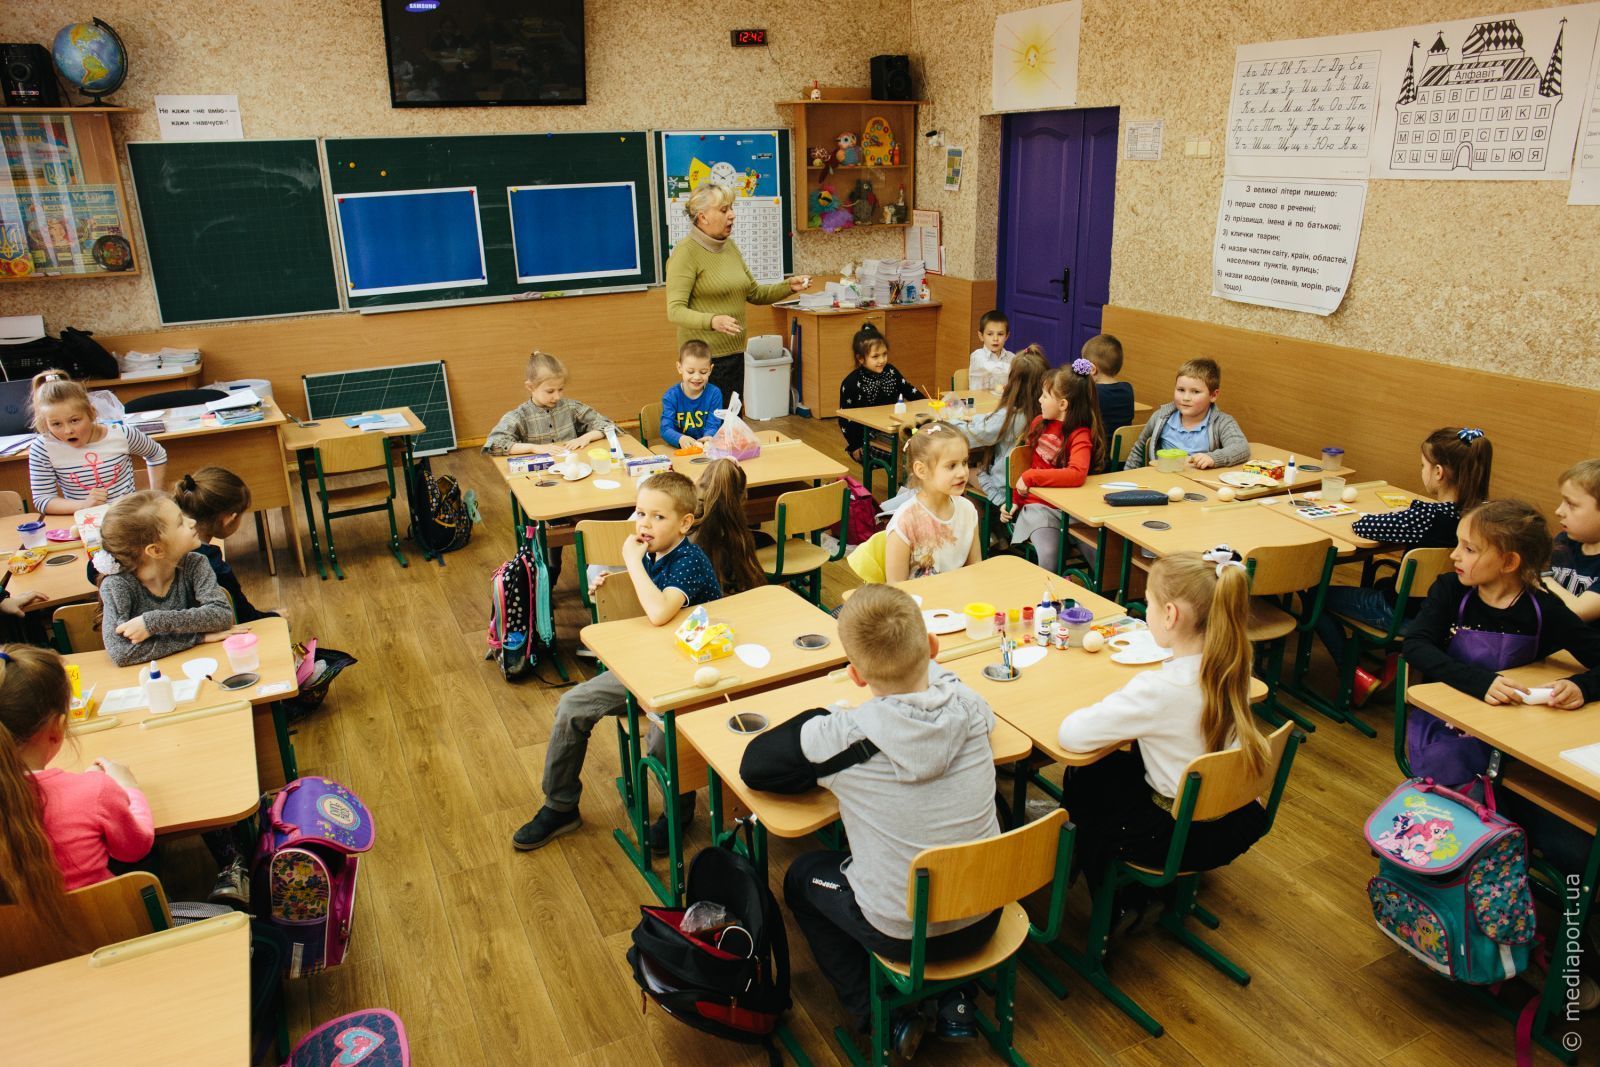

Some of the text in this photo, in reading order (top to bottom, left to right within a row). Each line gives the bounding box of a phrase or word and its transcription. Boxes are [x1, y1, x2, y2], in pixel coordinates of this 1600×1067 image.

[740, 32, 764, 42] 12:42
[1455, 69, 1496, 80] Алфавіт
[1420, 94, 1426, 102] А
[1435, 93, 1442, 101] Б
[1452, 92, 1458, 101] В
[1469, 92, 1475, 100] Г
[1503, 88, 1512, 98] Д
[1524, 87, 1531, 97] Е
[1402, 113, 1409, 122] Є
[1415, 113, 1425, 121] Ж
[1433, 112, 1439, 121] З
[1450, 111, 1457, 120] И
[1501, 106, 1509, 119] Й
[1520, 108, 1527, 118] К
[1537, 107, 1547, 117] Л
[1399, 128, 1544, 141] М Н О П Р С Т У Ф
[1397, 153, 1403, 161] Х
[1412, 153, 1419, 162] Ц
[1442, 152, 1451, 161] Ш
[1475, 152, 1486, 162] Щ
[1511, 151, 1521, 160] Ю
[1532, 151, 1539, 160] Я
[1280, 188, 1301, 196] літери
[1287, 204, 1316, 213] реченні;
[1232, 216, 1264, 225] прізвища,
[1307, 222, 1342, 231] батькові;
[1257, 233, 1281, 241] тварин;
[1249, 247, 1270, 255] частин
[1272, 248, 1290, 259] світу,
[1291, 252, 1311, 261] країн,
[1313, 254, 1348, 265] областей,
[1227, 257, 1320, 275] населених пунктів, вулиць;
[1224, 271, 1243, 280] назви
[1245, 274, 1269, 283] водойм
[1271, 278, 1299, 287] (океанів,
[1301, 282, 1324, 292] морів,
[1326, 284, 1341, 293] річок
[1224, 283, 1242, 292] тощо).
[677, 410, 708, 433] FAS
